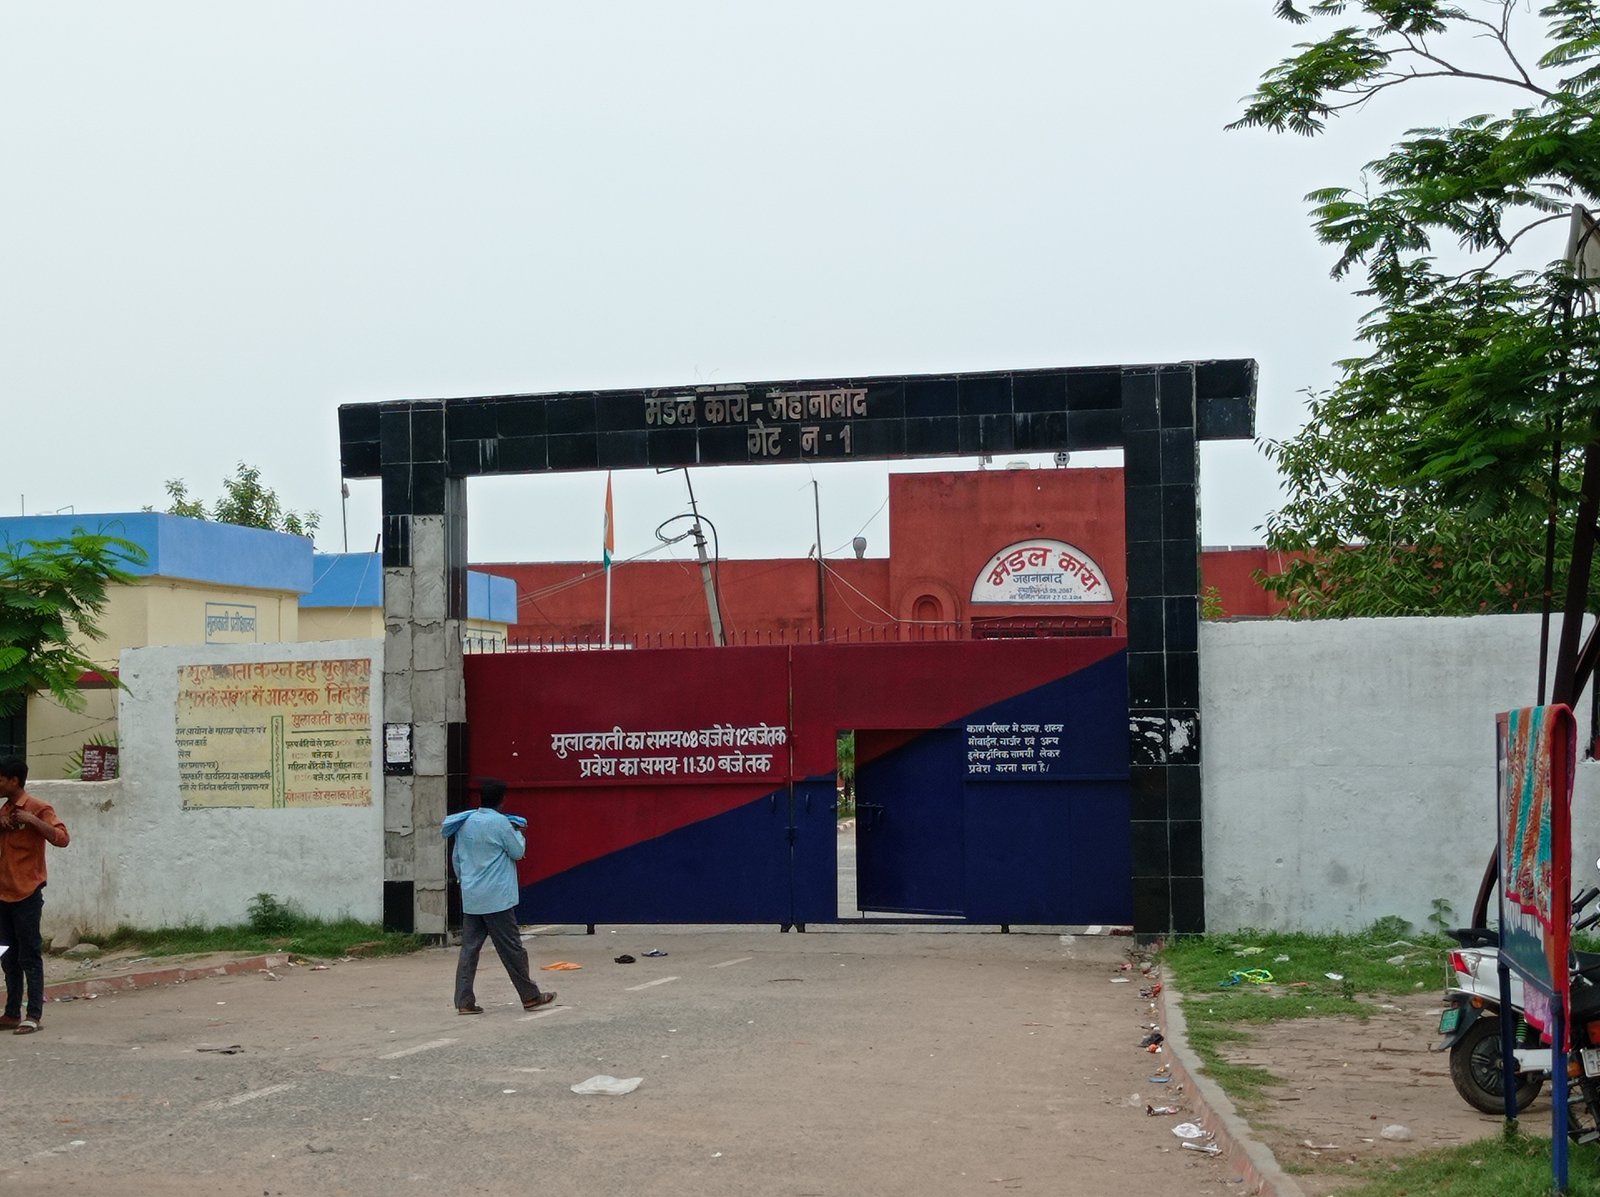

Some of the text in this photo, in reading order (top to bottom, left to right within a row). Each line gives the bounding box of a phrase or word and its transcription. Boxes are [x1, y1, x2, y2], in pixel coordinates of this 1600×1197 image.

[644, 390, 697, 425] मंडल
[748, 418, 782, 456] गेट
[986, 546, 1101, 593] मंडल कारा
[1013, 573, 1064, 584] जहानाबाद
[551, 725, 626, 759] मुलाकाती
[625, 732, 647, 750] का
[966, 724, 985, 733] कारा
[986, 722, 1010, 734] परिसर
[578, 753, 618, 779] प्रवेश
[619, 758, 640, 776] का
[717, 750, 745, 774] बजे
[745, 754, 773, 774] तक
[1010, 747, 1035, 759] सामग्री
[1039, 747, 1061, 758] लेकर
[967, 762, 991, 774] प्रवेश
[995, 763, 1018, 773] करना
[1021, 763, 1037, 772] मना
